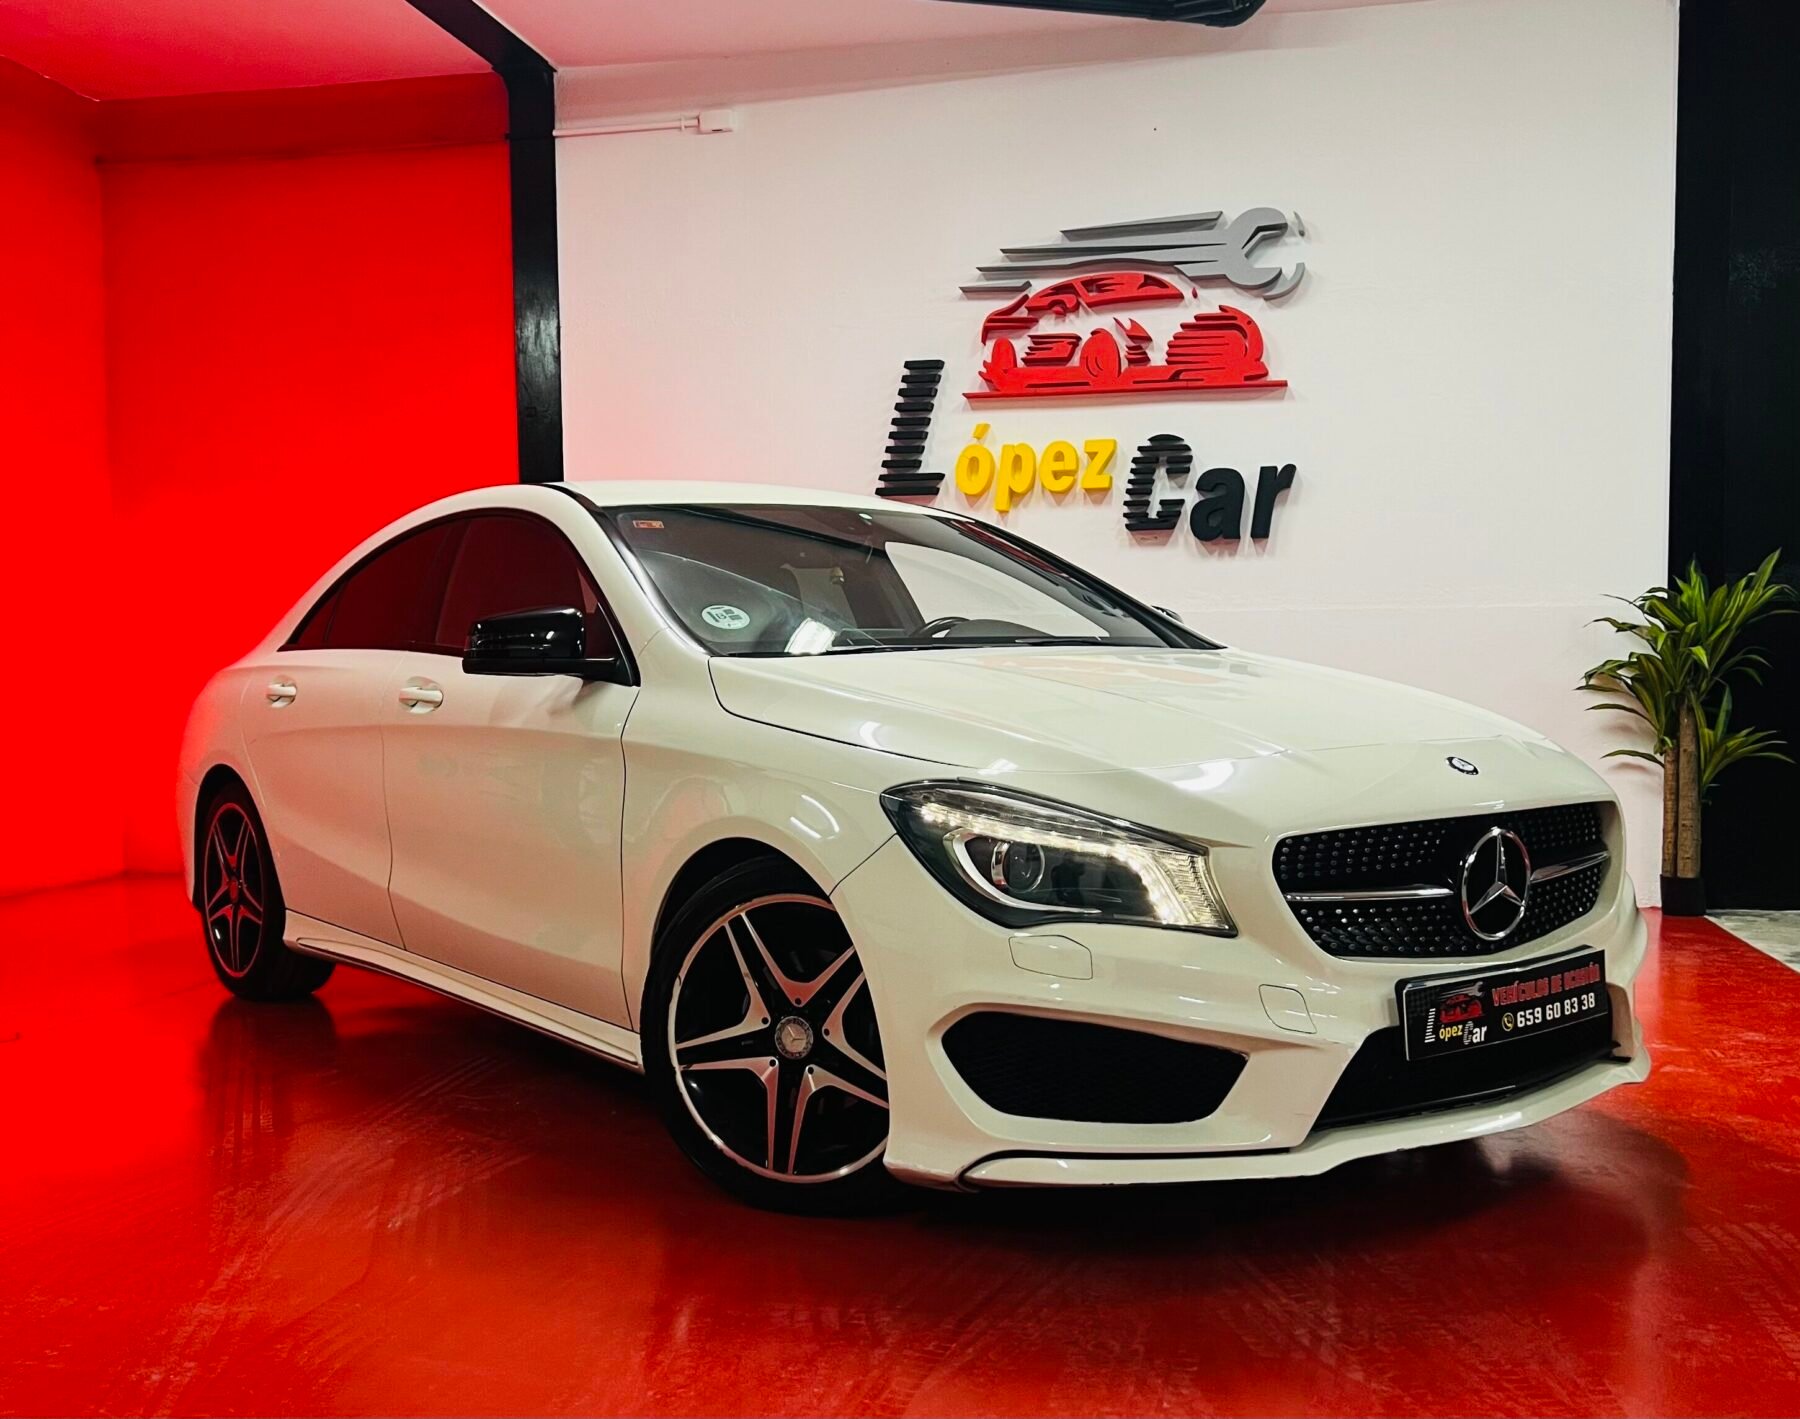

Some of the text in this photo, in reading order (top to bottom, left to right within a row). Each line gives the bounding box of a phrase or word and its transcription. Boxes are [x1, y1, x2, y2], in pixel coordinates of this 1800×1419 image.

[875, 360, 1297, 541] López Car
[1551, 974, 1562, 993] DE
[1424, 1008, 1487, 1045] López Car
[1517, 992, 1595, 1028] 659 60 83 38
